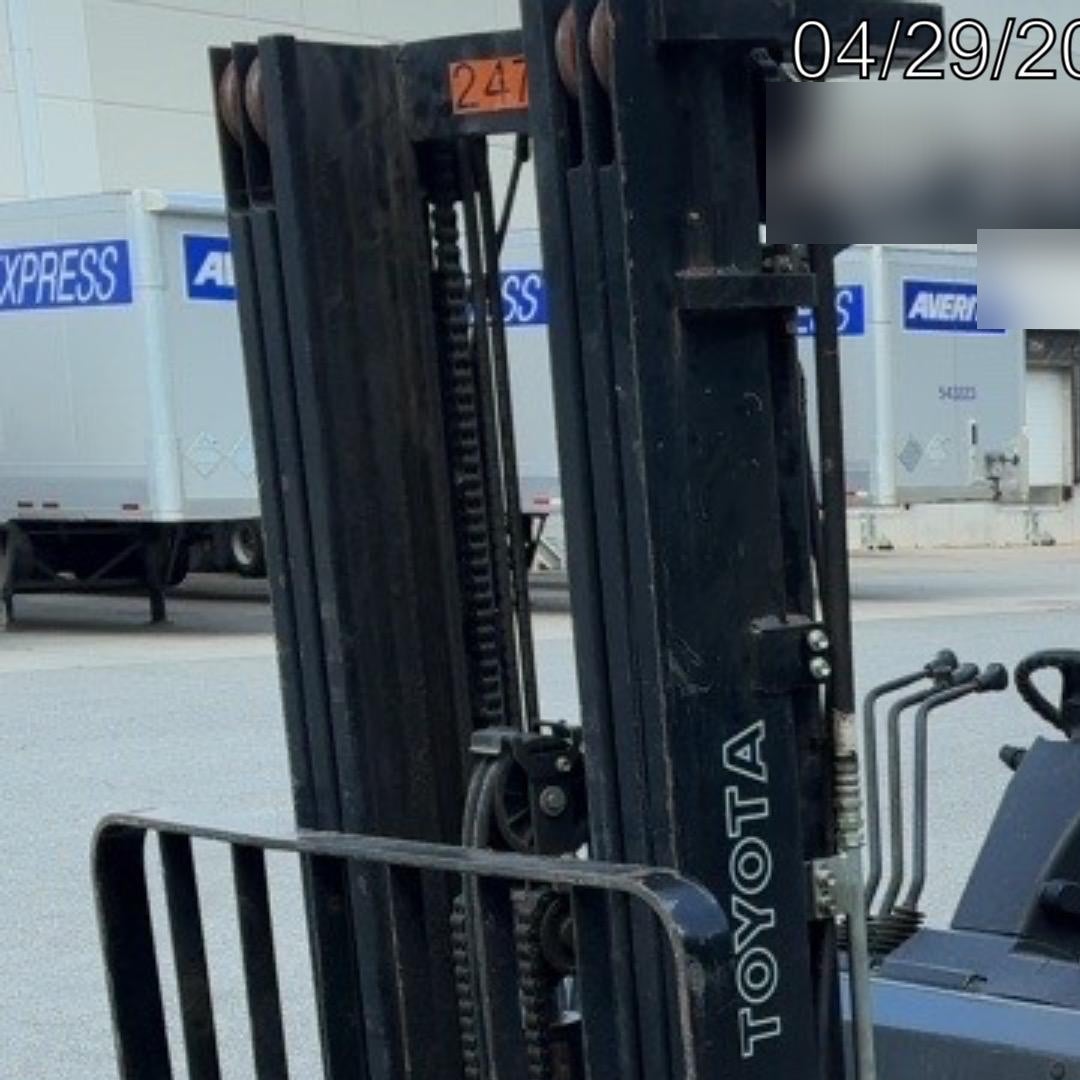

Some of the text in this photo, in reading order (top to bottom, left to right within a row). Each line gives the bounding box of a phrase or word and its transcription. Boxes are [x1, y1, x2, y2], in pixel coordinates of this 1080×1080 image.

[0, 245, 119, 304] XPRESS
[908, 290, 978, 322] AVERI
[722, 718, 782, 1060] TOYOTA
